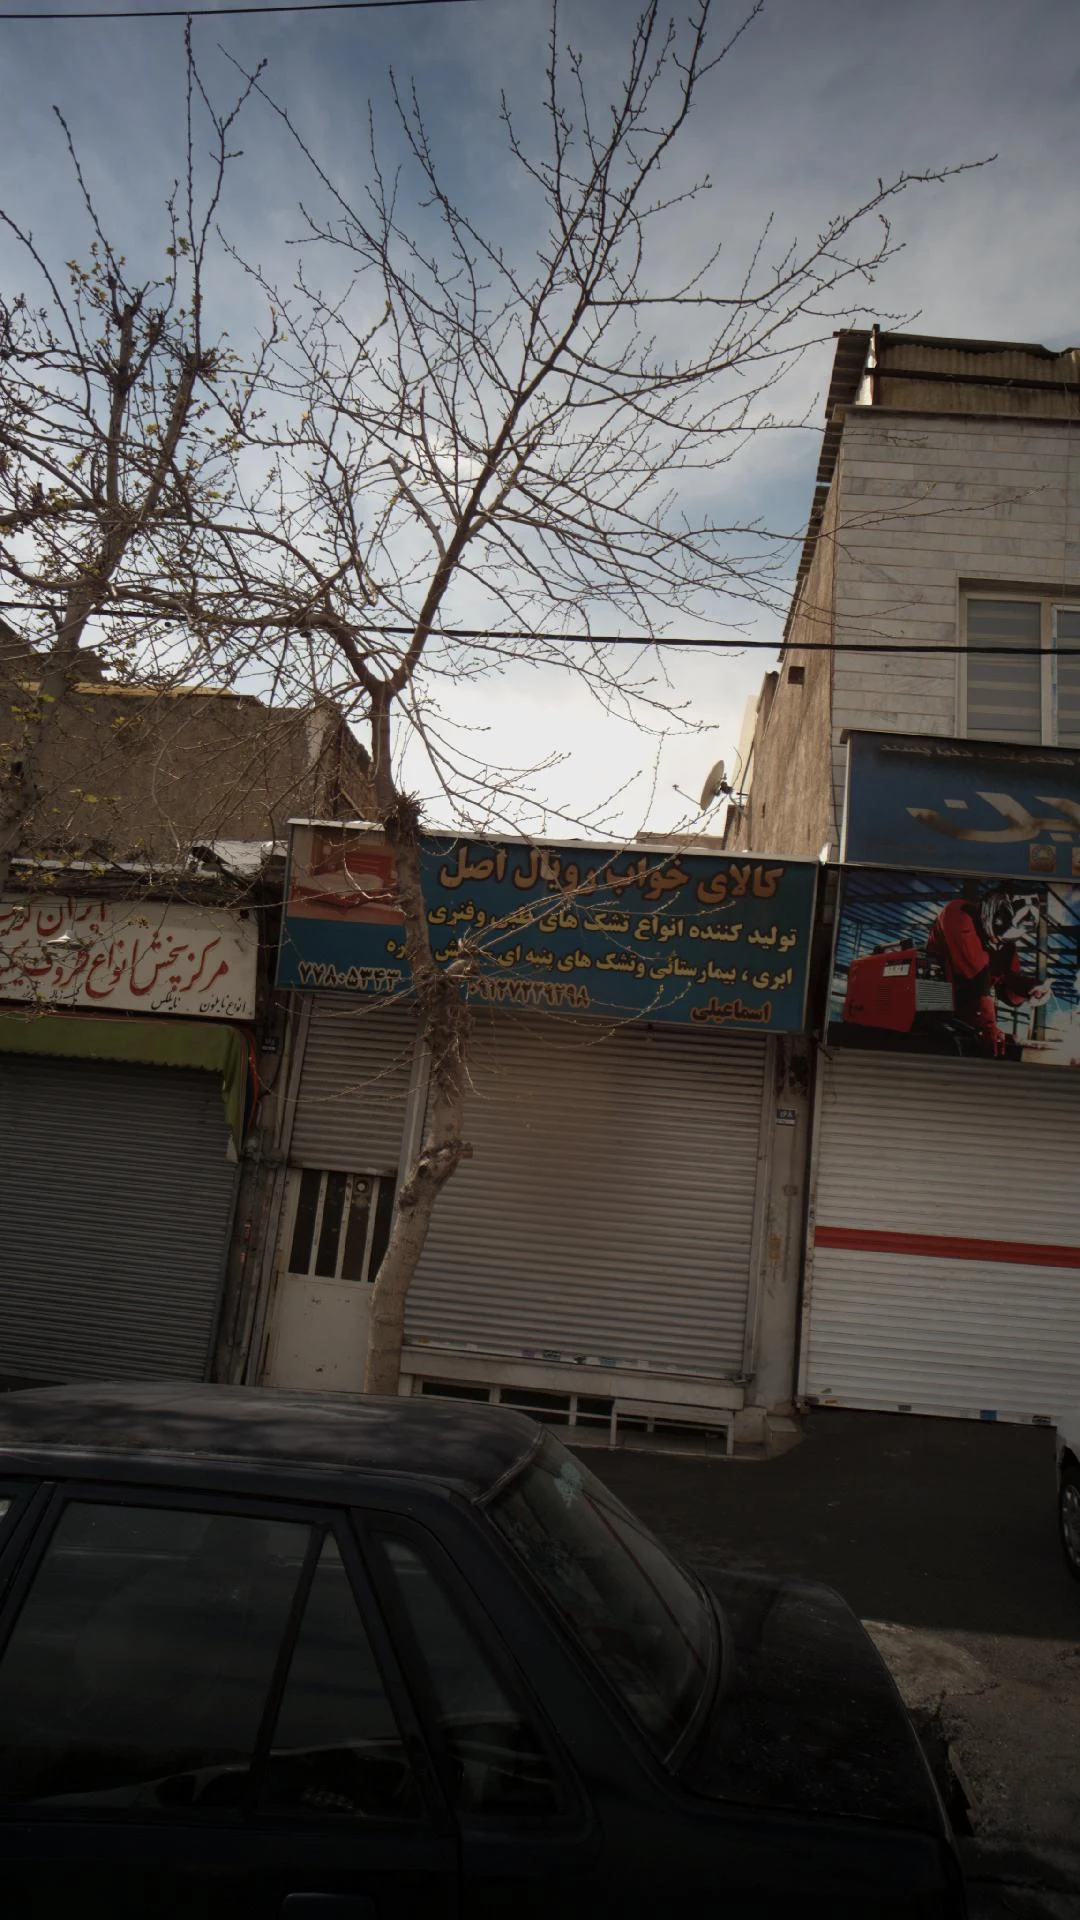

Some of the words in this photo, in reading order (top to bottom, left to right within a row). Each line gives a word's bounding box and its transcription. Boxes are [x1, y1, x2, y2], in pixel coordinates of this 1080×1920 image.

[440, 846, 508, 888] اصل
[605, 856, 691, 901] خواب
[696, 863, 785, 904] کالای
[539, 909, 578, 933] های
[583, 912, 630, 932] تشک
[634, 917, 683, 942] انواع
[689, 923, 742, 943] کننده
[748, 926, 797, 952] تولید
[86, 940, 127, 998] انواع
[129, 931, 189, 996] پخش
[179, 937, 229, 993] مرکز
[525, 949, 553, 969] پنبه
[557, 950, 591, 972] های
[650, 957, 736, 984] بیمارستانی
[752, 968, 793, 990] ابری
[690, 997, 772, 1022] اسماعیلی
